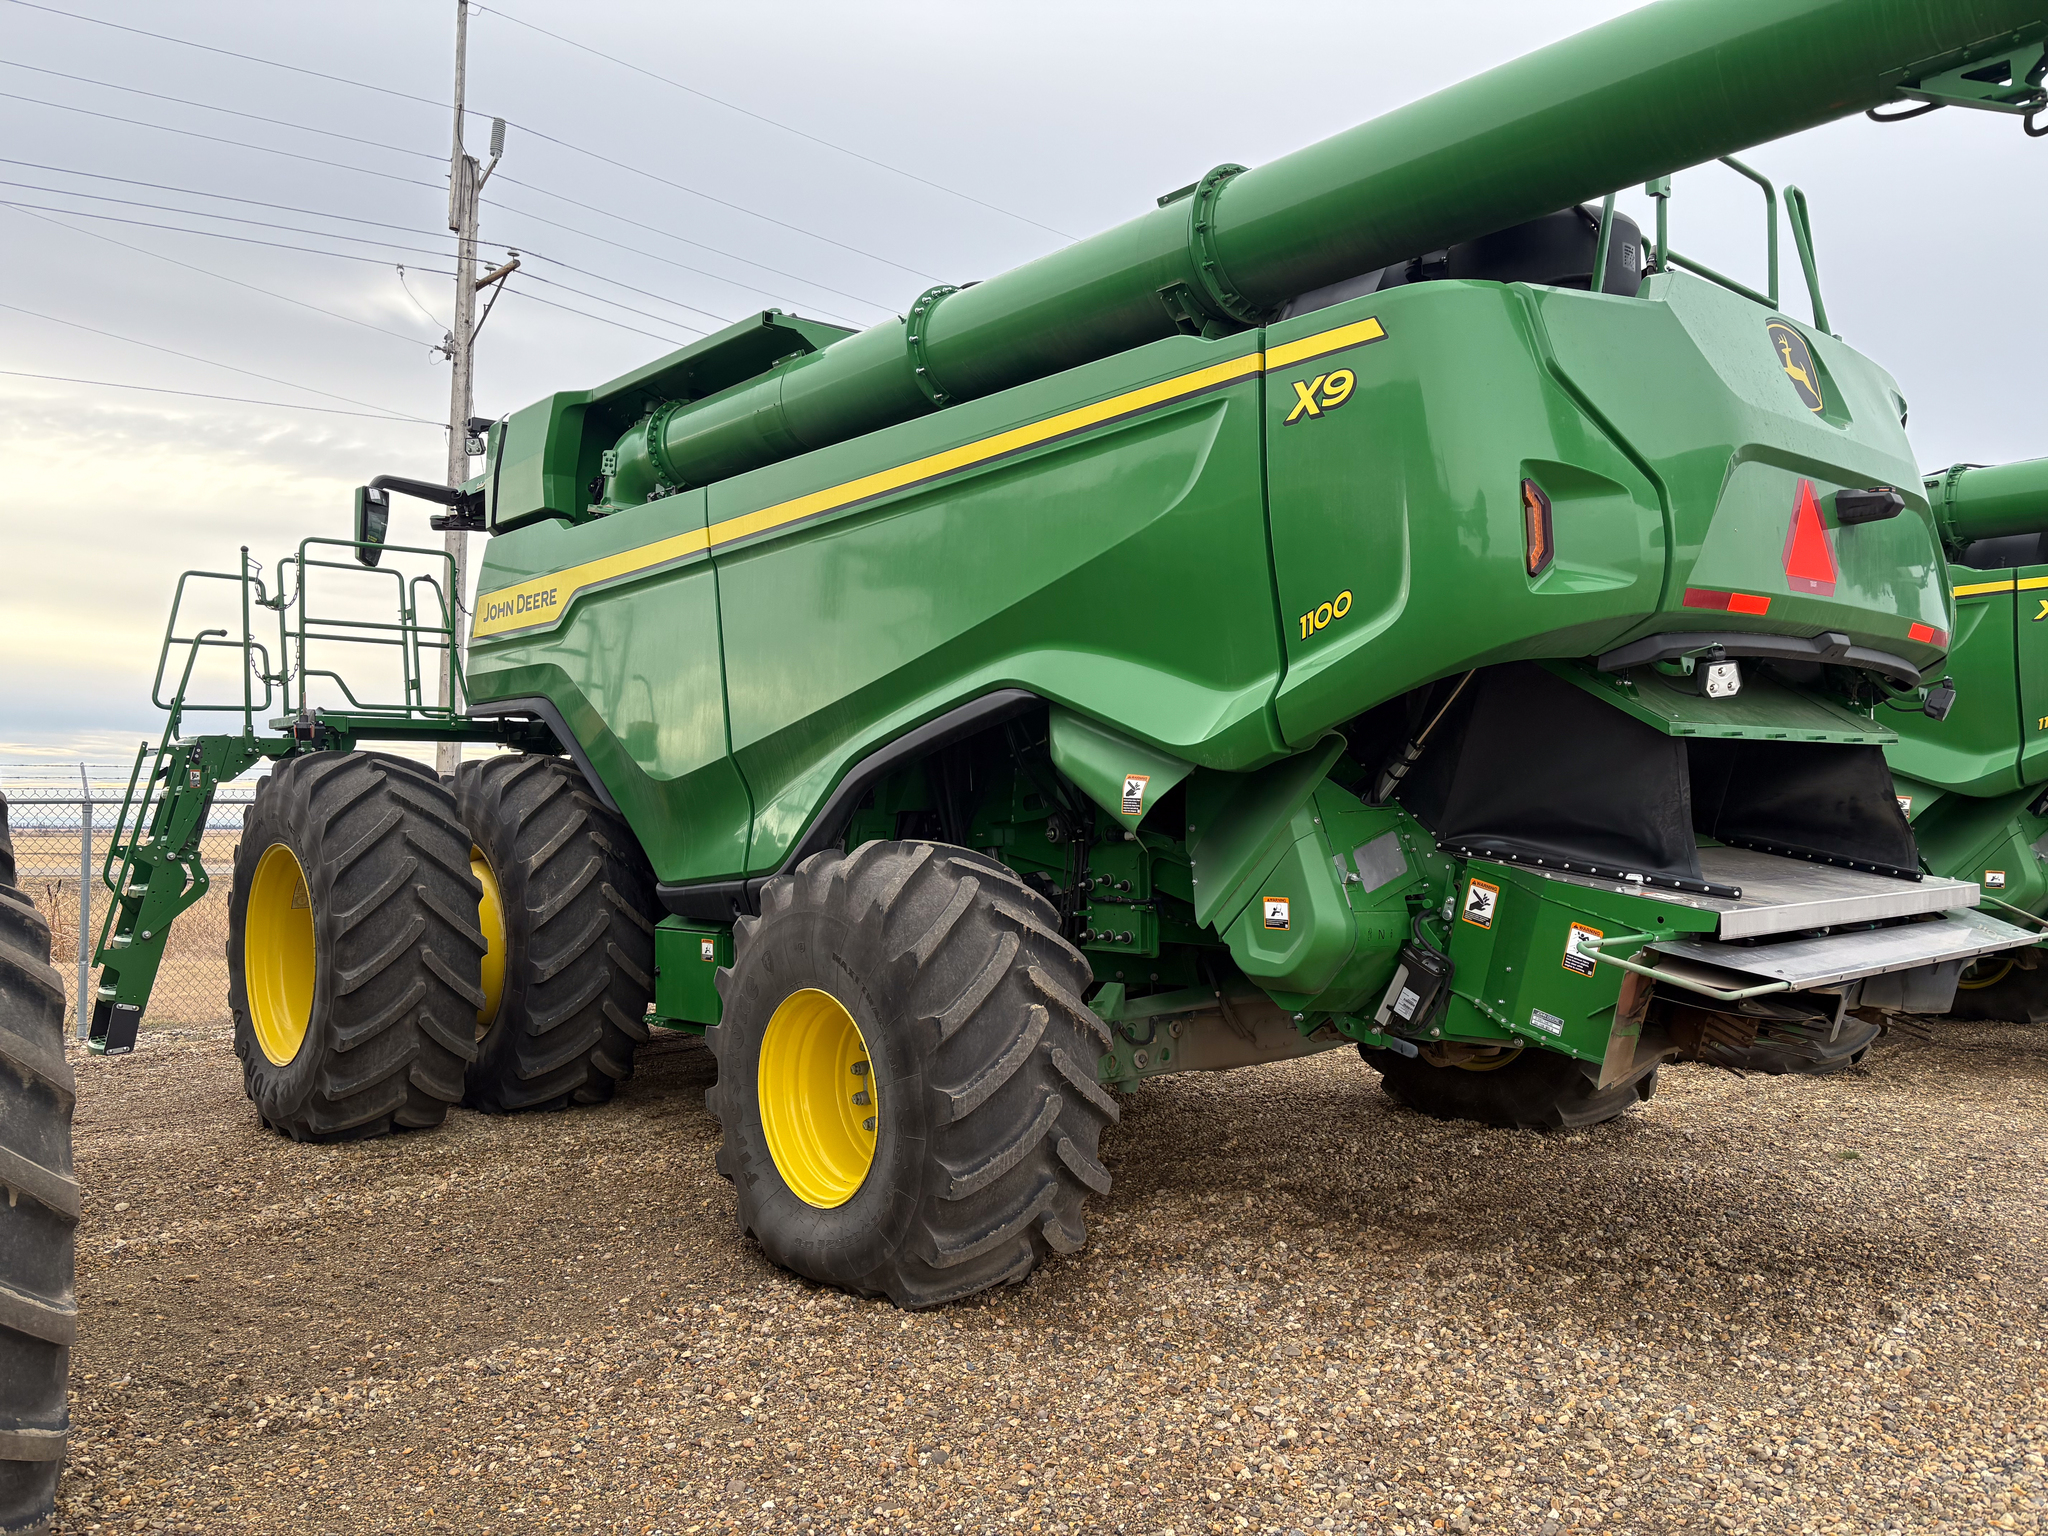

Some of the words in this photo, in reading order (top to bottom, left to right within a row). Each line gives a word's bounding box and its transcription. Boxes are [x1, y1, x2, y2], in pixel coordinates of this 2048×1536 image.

[1283, 368, 1357, 427] X9
[483, 600, 514, 623] JOHN
[516, 588, 558, 614] DEERE
[1299, 588, 1354, 641] 1100
[2031, 599, 2048, 622] X
[2038, 716, 2048, 731] 11
[1477, 881, 1498, 893] WARNING
[1579, 926, 1601, 936] WARNING
